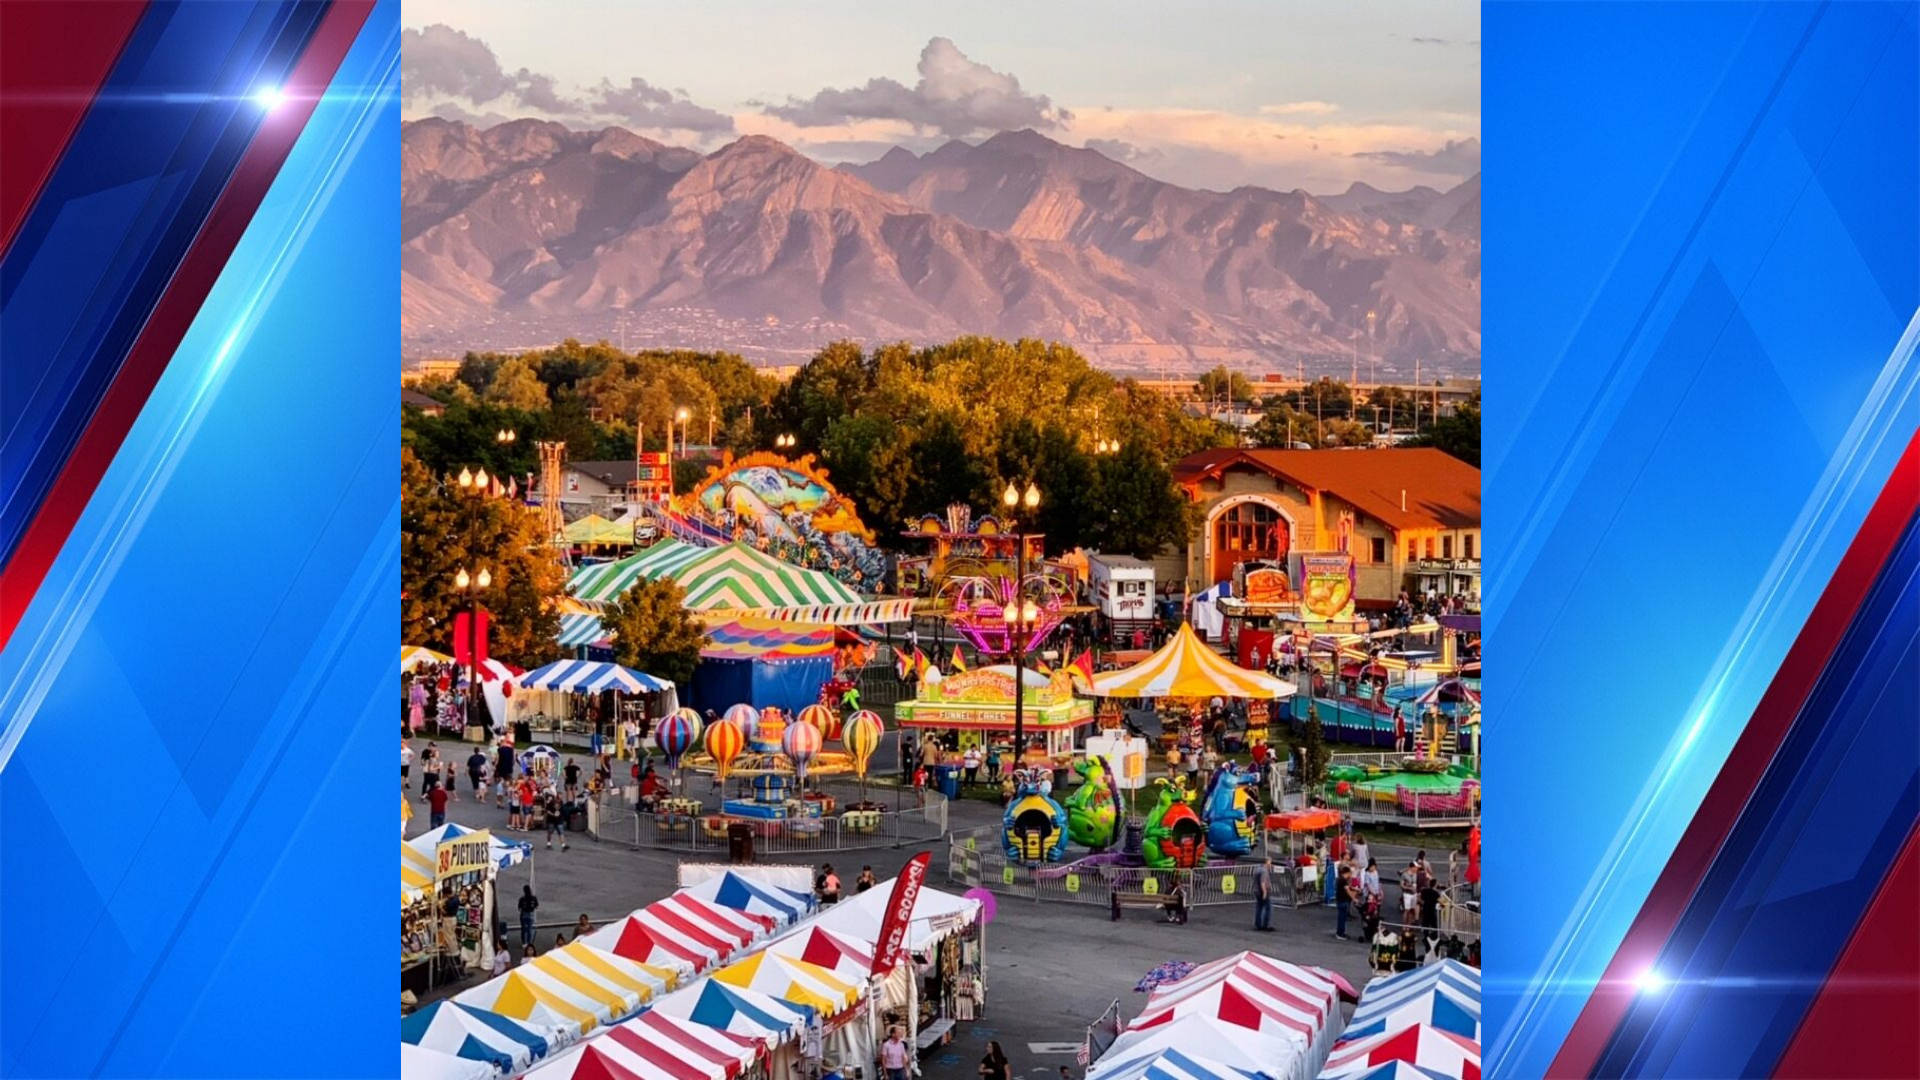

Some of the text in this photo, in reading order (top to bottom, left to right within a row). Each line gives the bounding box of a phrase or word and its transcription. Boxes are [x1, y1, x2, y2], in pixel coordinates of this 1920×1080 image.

[451, 842, 489, 866] PICTURES
[882, 858, 925, 966] FREE BOOKS!
